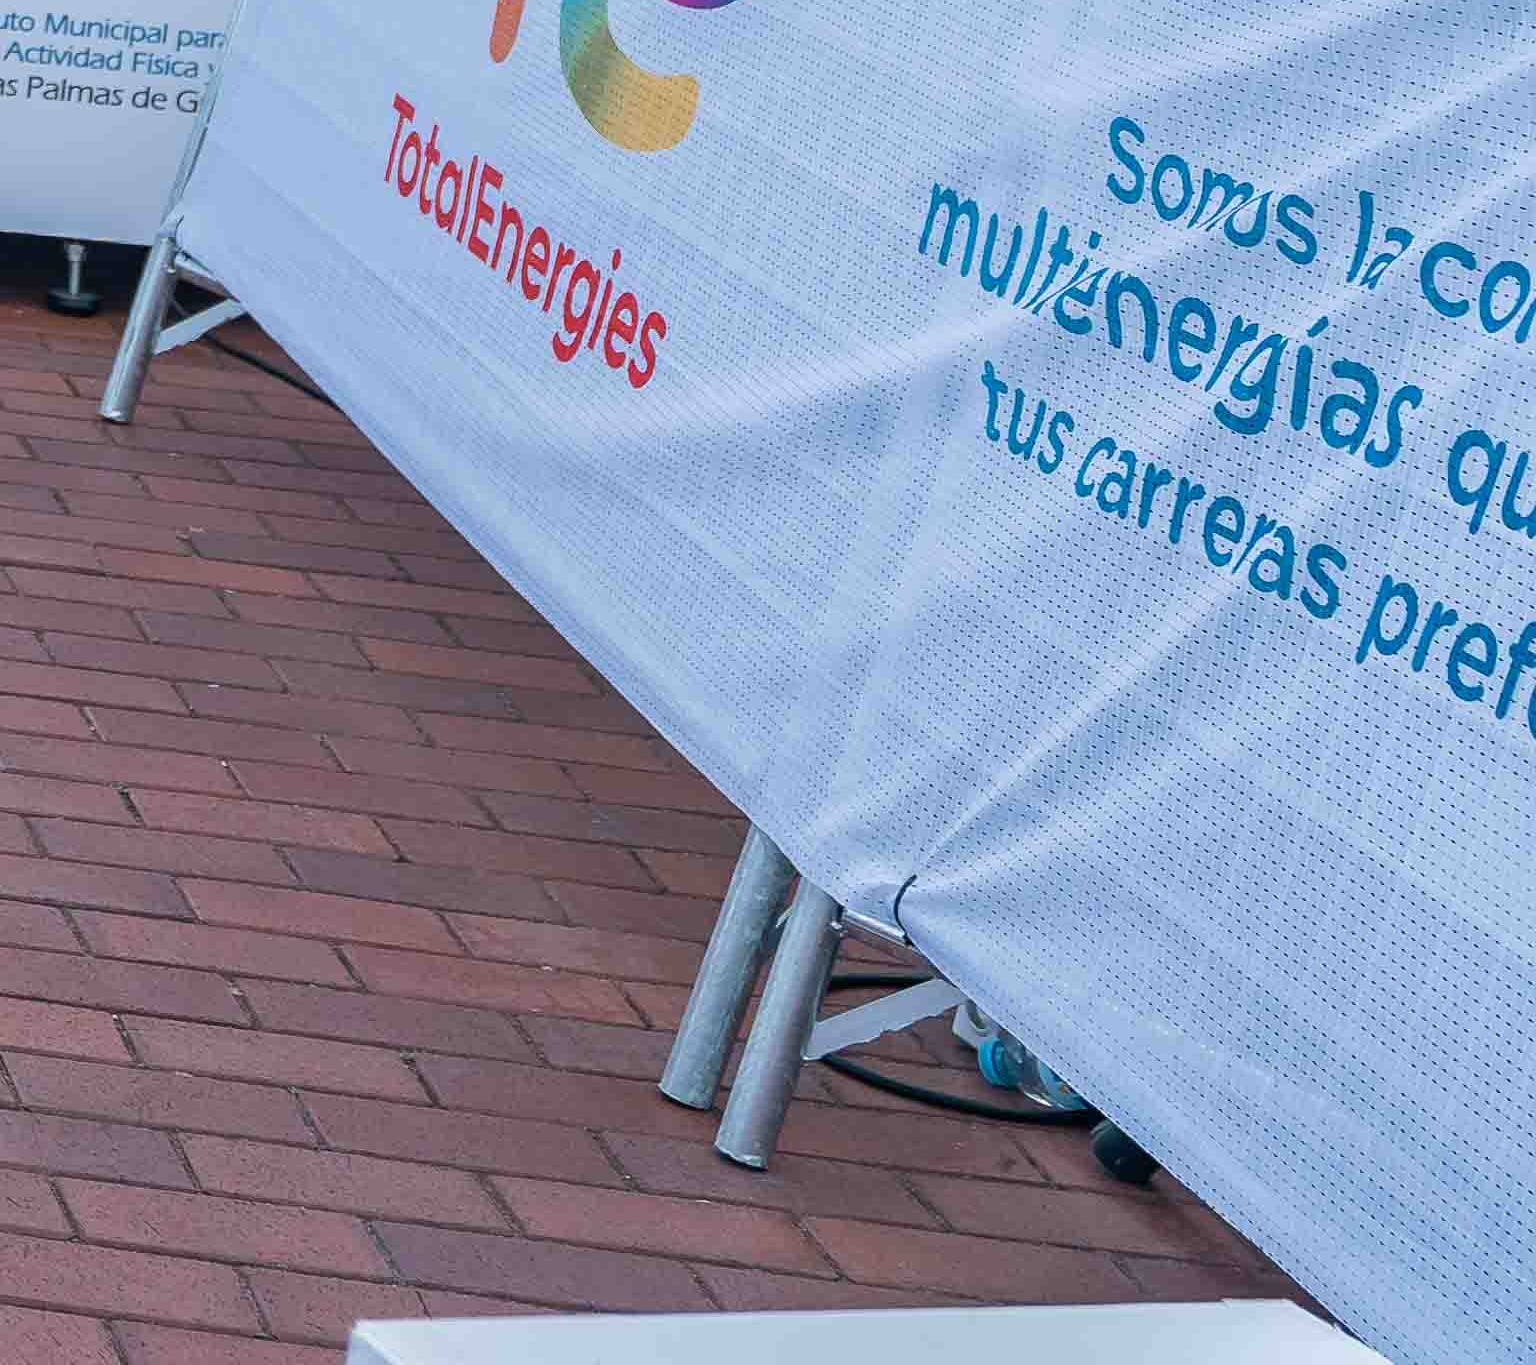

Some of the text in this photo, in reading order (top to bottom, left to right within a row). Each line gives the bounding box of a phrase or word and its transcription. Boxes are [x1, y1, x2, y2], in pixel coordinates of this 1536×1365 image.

[44, 13, 167, 47] Municipal
[3, 42, 122, 71] Actividad
[27, 77, 123, 107] Palmas
[132, 84, 167, 111] de
[383, 93, 667, 390] TotalEnergies
[983, 360, 1077, 475] tus
[1074, 437, 1348, 620] carreras
